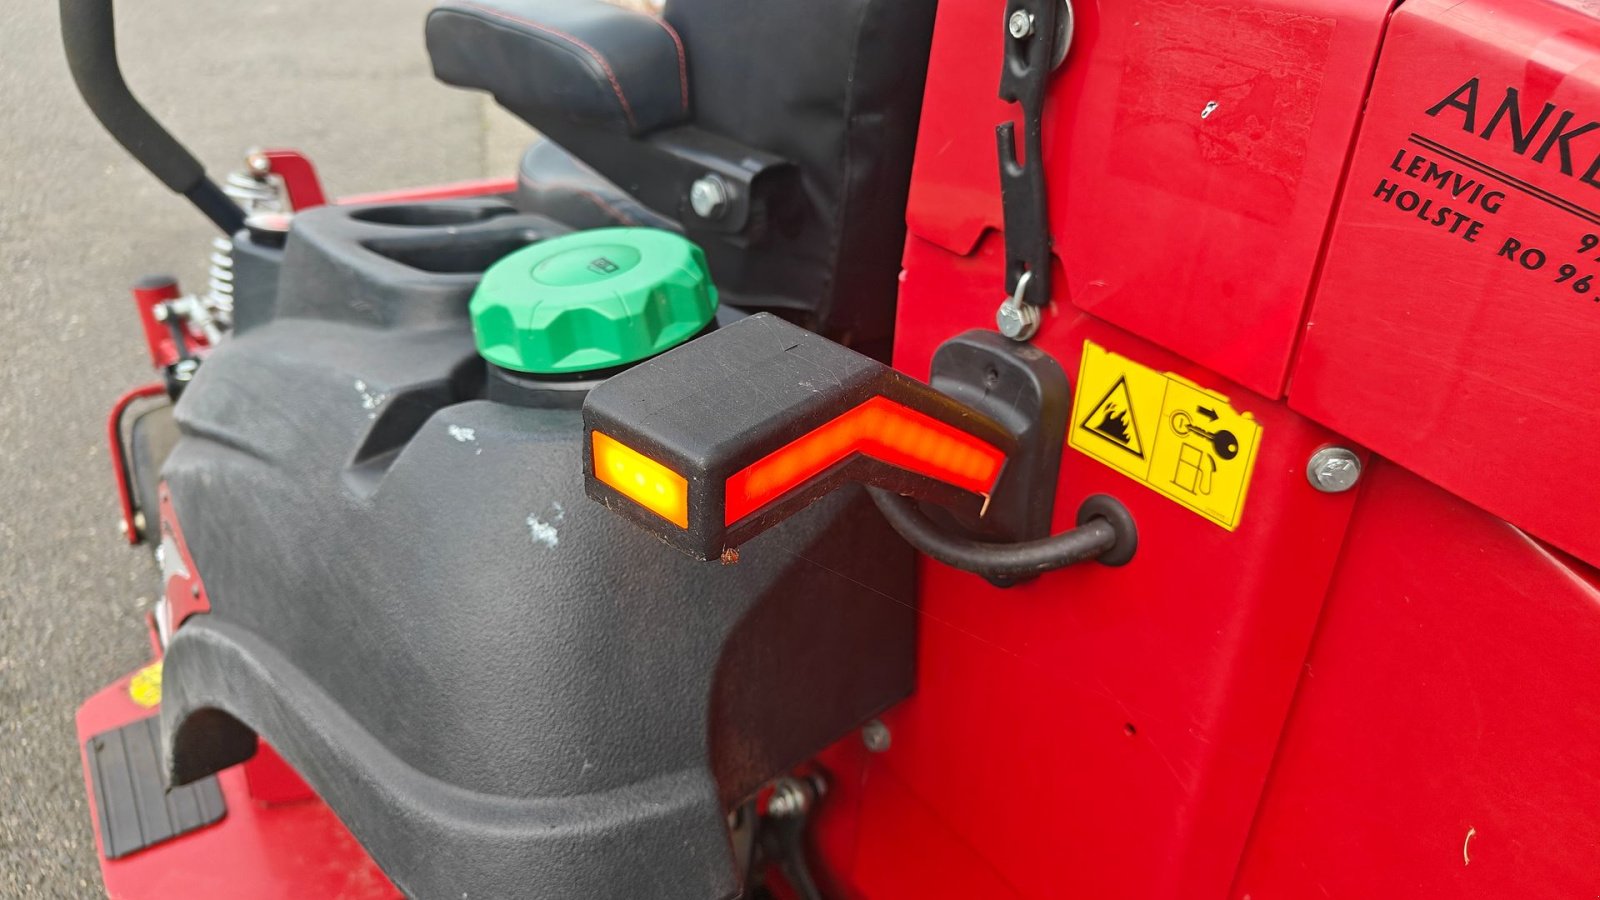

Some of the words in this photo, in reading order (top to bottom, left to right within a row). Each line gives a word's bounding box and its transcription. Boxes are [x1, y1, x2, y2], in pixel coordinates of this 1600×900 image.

[1373, 179, 1484, 243] HOLSTE
[1497, 237, 1546, 270] RO
[1390, 149, 1505, 214] LEMVIG
[1577, 233, 1600, 263] 9
